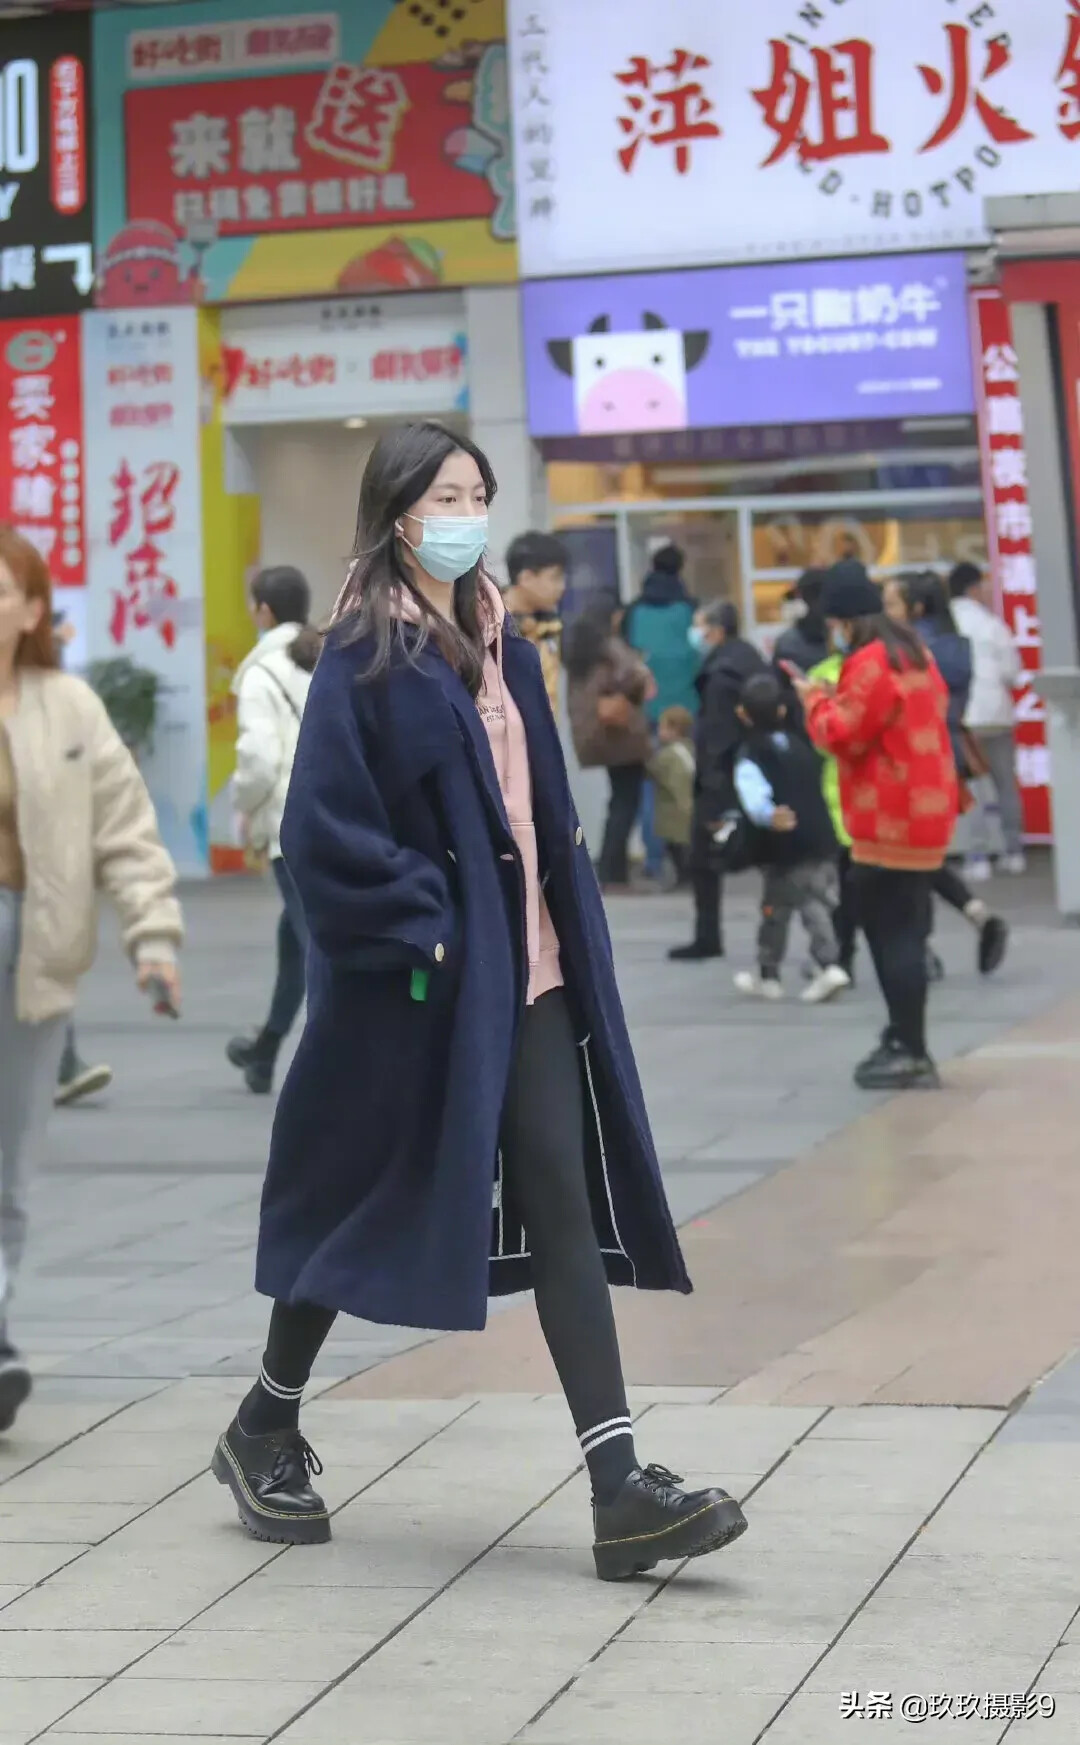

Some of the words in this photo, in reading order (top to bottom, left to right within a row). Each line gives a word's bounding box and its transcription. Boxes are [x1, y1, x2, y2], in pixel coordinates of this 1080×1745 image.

[169, 61, 412, 179] 来就送
[613, 2, 1080, 176] 萍姐火
[869, 145, 1001, 219] HOTPO
